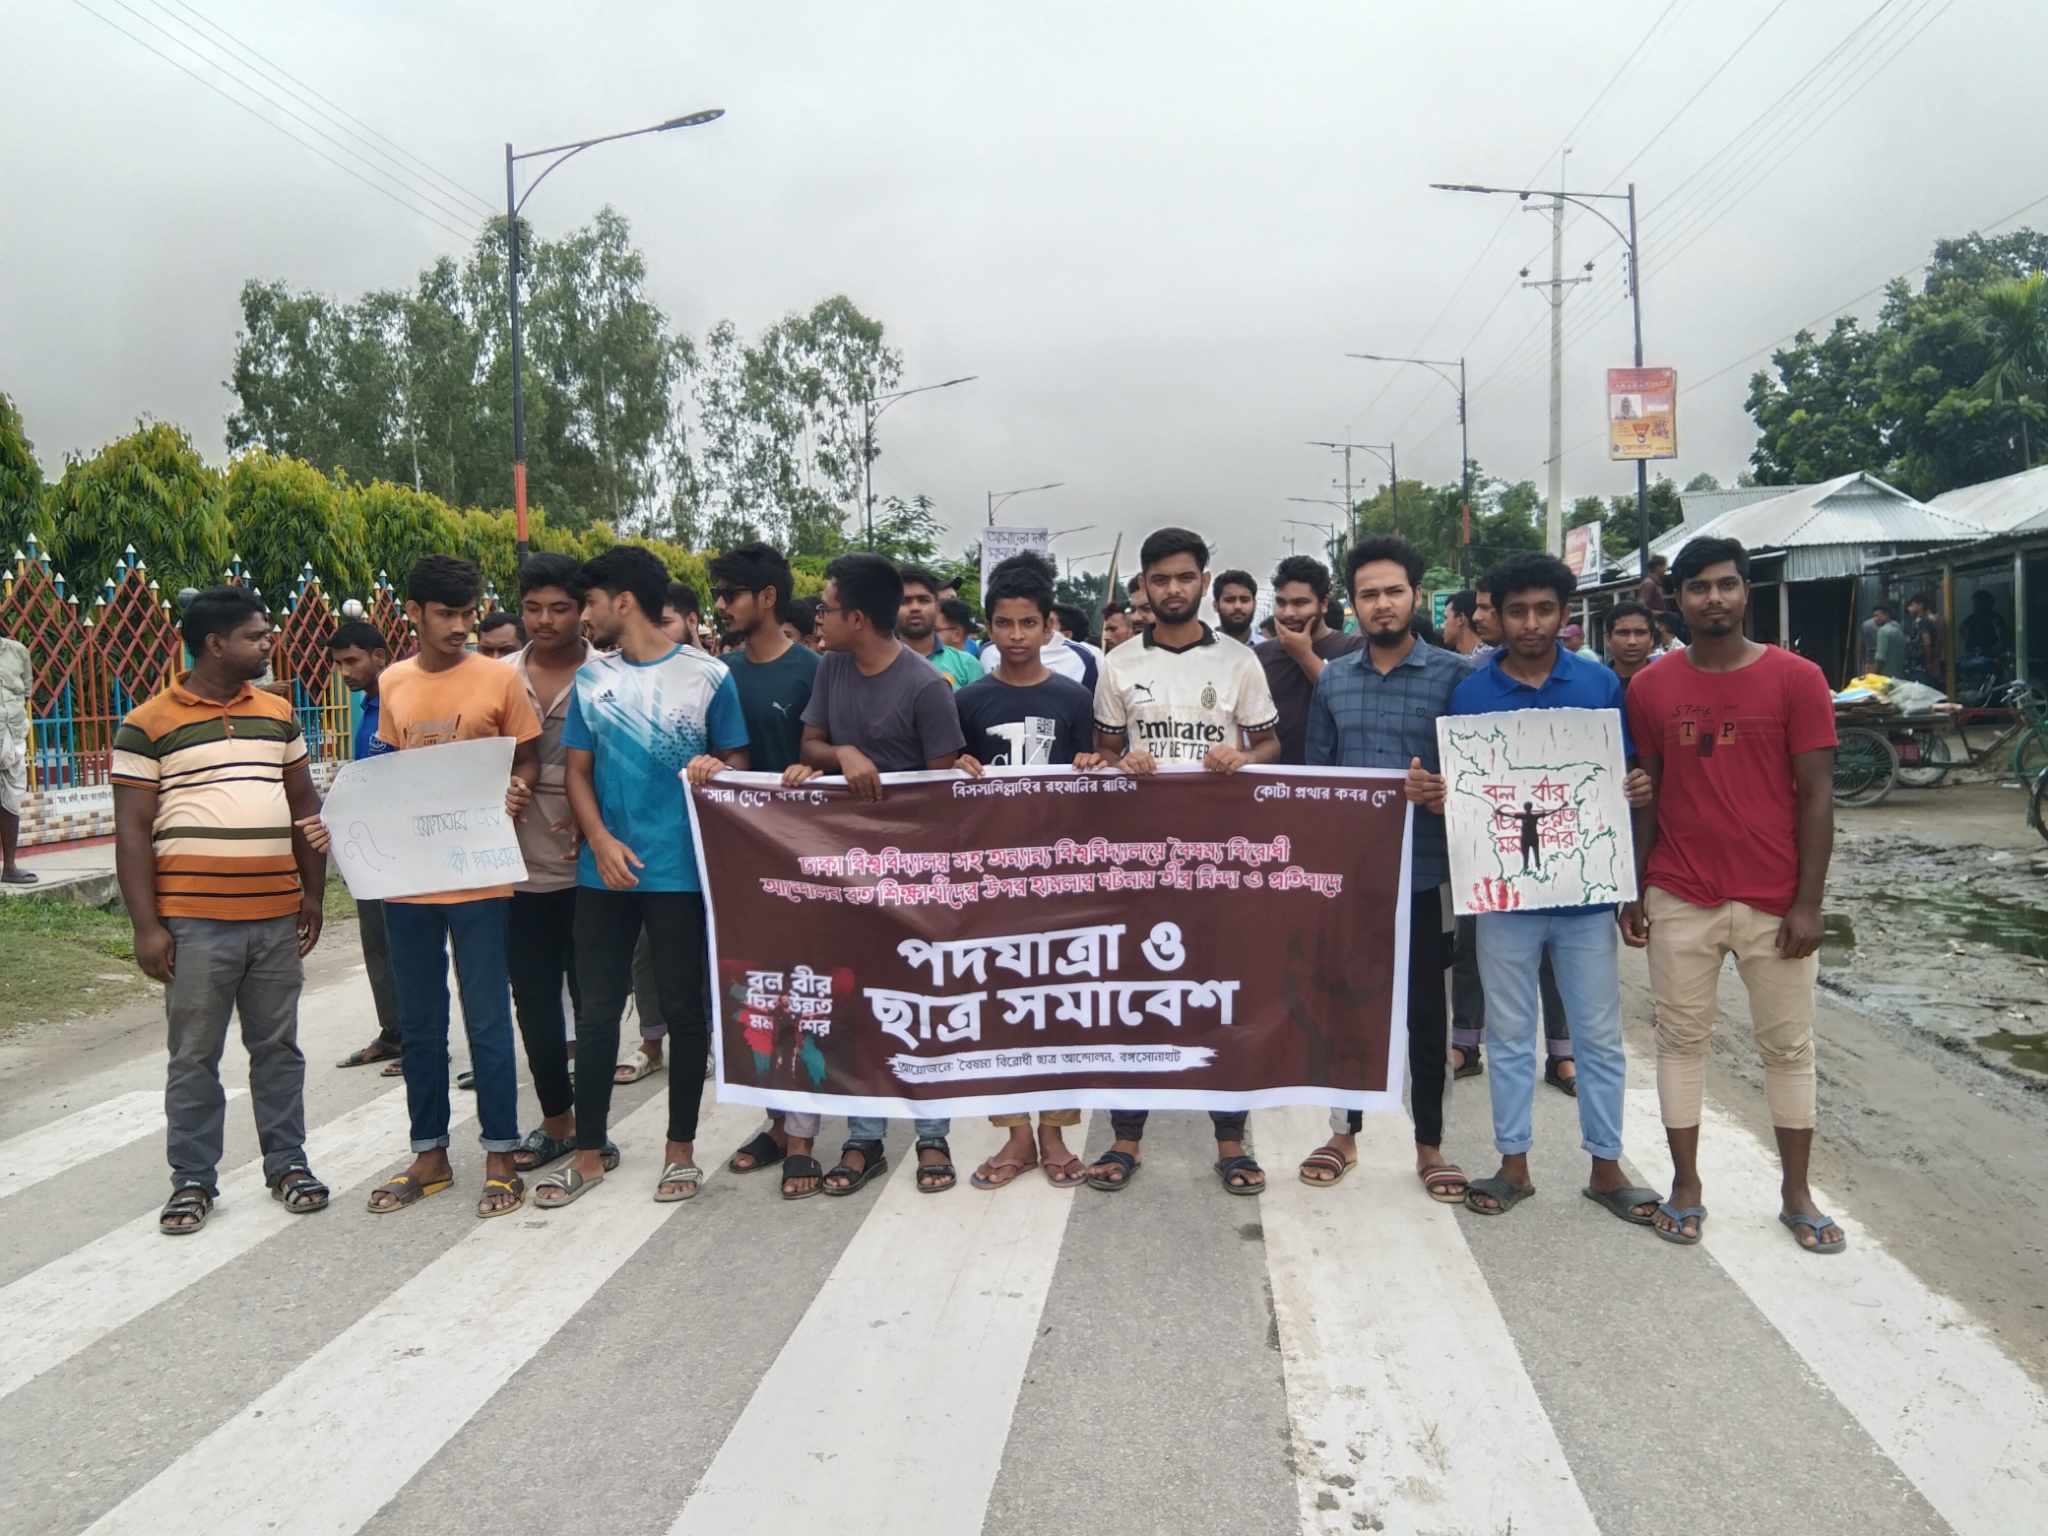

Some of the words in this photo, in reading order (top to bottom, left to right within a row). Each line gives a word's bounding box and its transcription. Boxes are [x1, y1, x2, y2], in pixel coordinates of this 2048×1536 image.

[1136, 716, 1225, 742] Emirates
[1721, 722, 1735, 738] P
[1149, 742, 1168, 758] FLY
[1254, 782, 1291, 802] কোটা
[1295, 785, 1331, 800] প্রথার
[1334, 787, 1369, 802] কবর
[1482, 784, 1517, 803] বল
[1530, 774, 1570, 803] বীর
[798, 855, 844, 877] ঢাকা
[845, 847, 950, 876] বিশ্ববিদ্যালয়
[952, 850, 985, 872] সহ
[986, 847, 1052, 870] অন্যান্য
[1053, 837, 1166, 865] বিশ্ববিদ্যালয়ে
[1225, 835, 1291, 866] বিরোধী
[980, 874, 1028, 898] উপর
[1029, 873, 1095, 897] হামলার
[1195, 863, 1240, 889] নিন্দা
[1243, 870, 1264, 888] ও
[1267, 865, 1344, 898] প্রতিবাদে
[897, 924, 1127, 987] পদযাত্রা
[1141, 921, 1187, 972] ও
[745, 970, 784, 994] বল
[789, 965, 833, 998] বীর
[863, 987, 988, 1050] ছাত্র
[997, 980, 1241, 1031] সমাবেশ
